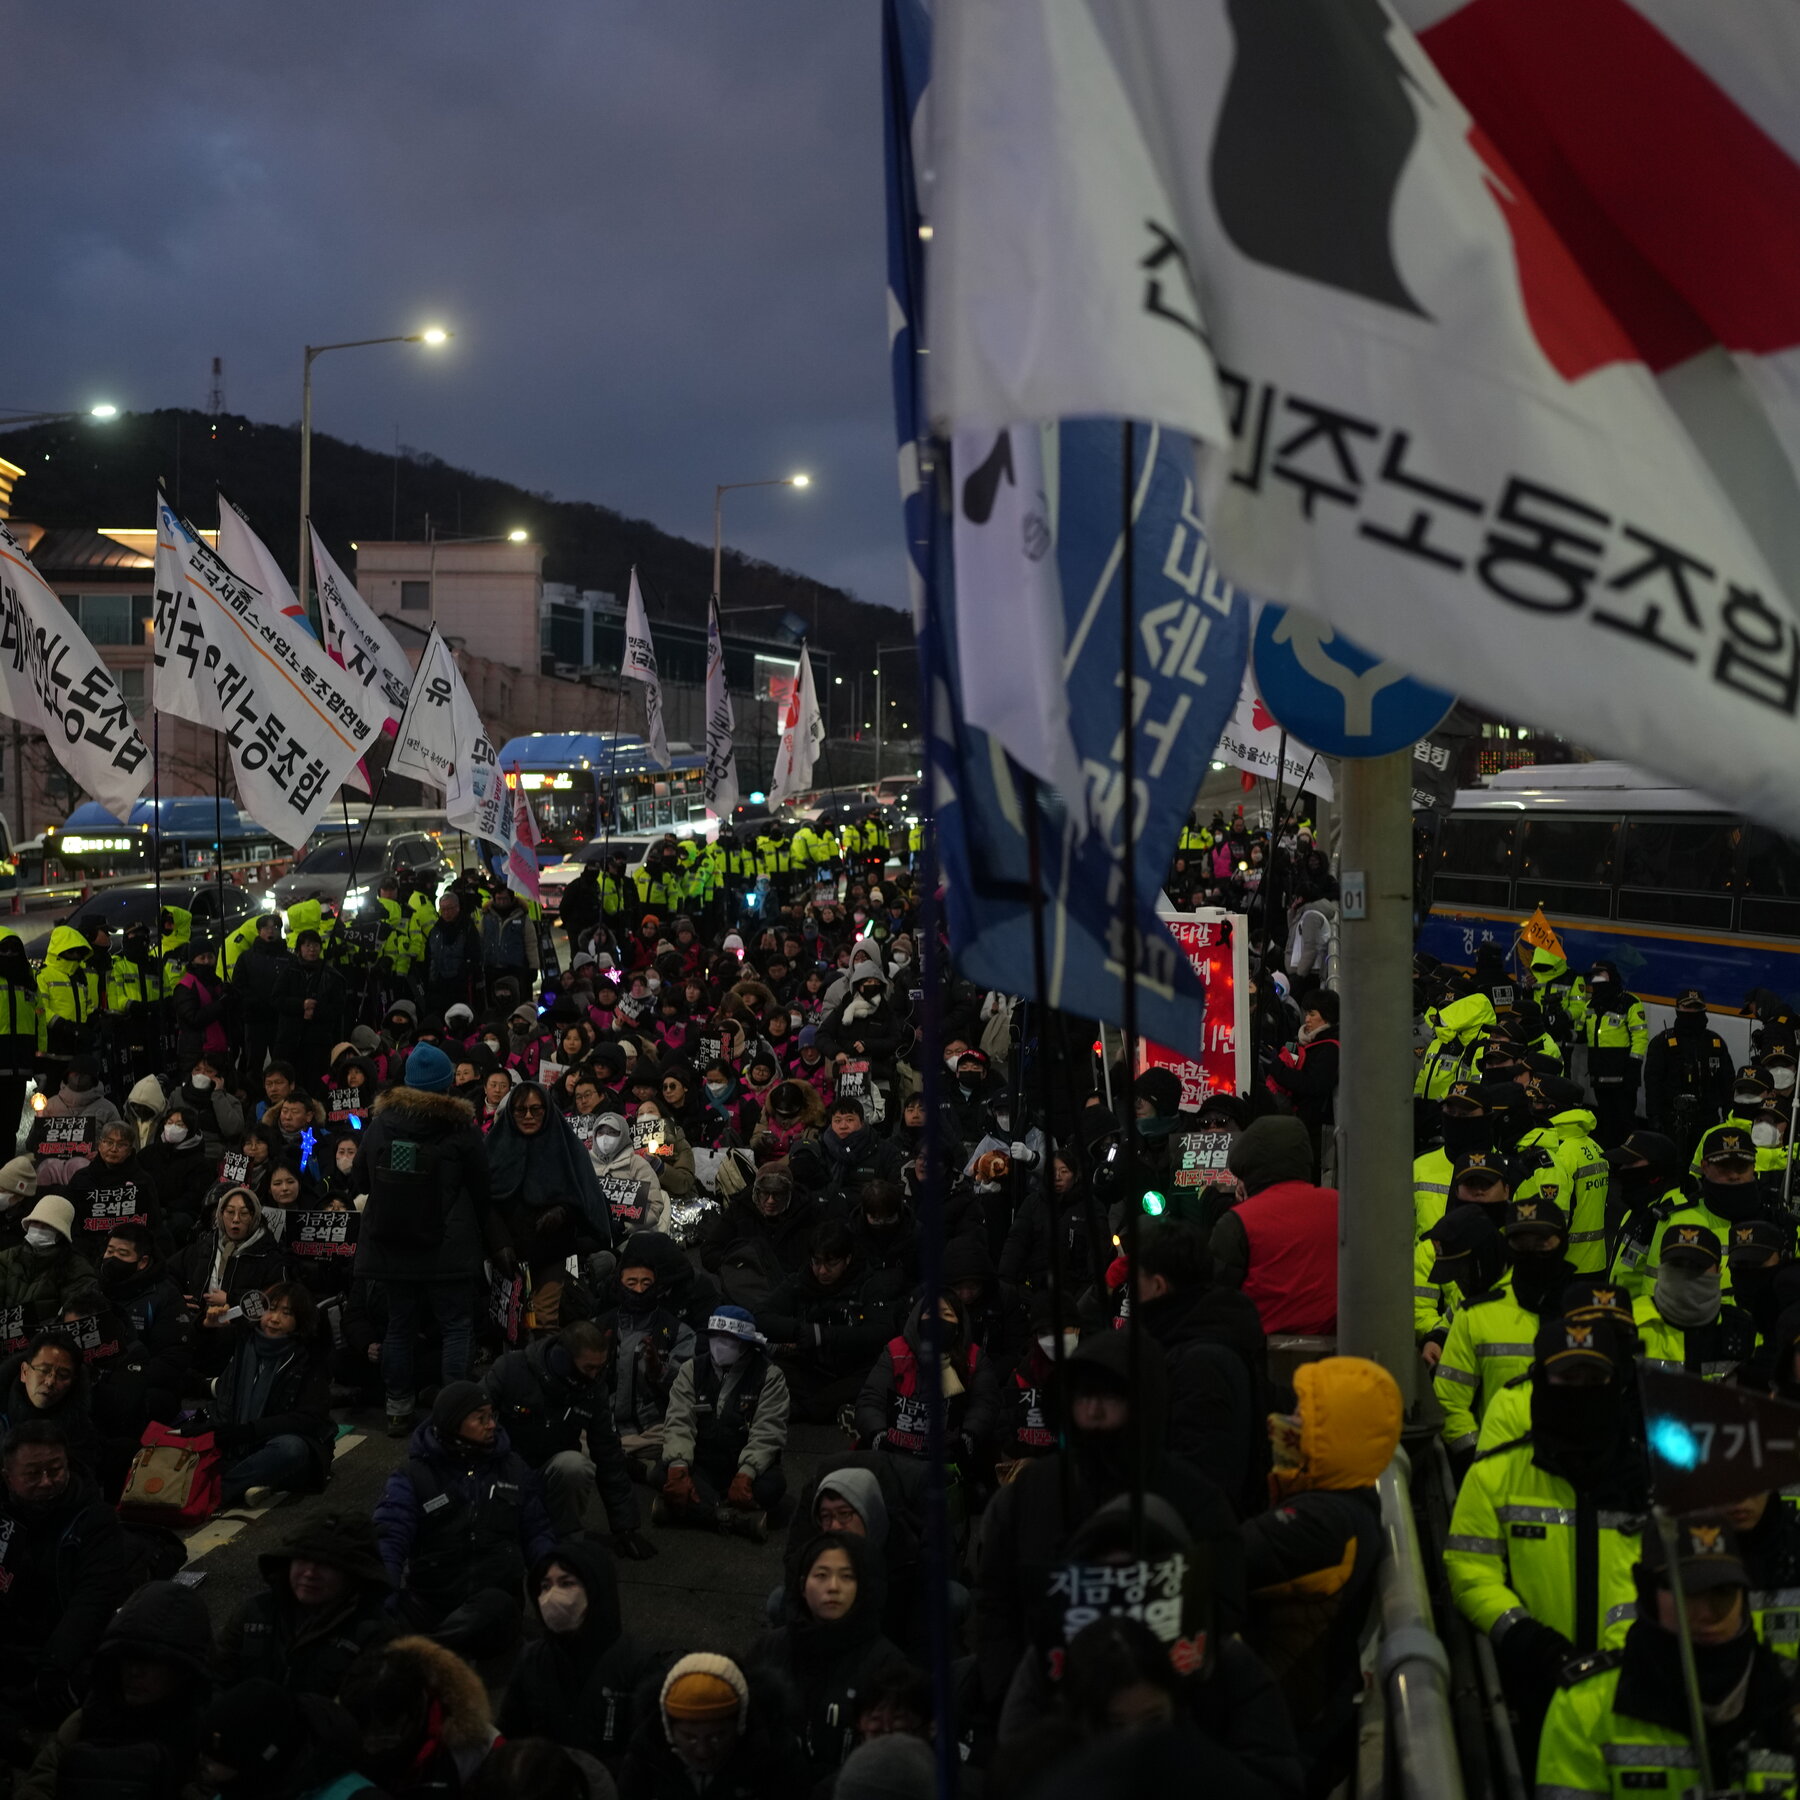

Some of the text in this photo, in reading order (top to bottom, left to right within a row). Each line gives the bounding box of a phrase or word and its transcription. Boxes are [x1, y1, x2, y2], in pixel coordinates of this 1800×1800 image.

[1345, 891, 1362, 909] 01
[43, 1117, 88, 1129] 지금당장
[629, 1119, 666, 1136] 지금당장
[46, 1128, 86, 1143] 윤석열
[1178, 1132, 1234, 1151] 지금당장
[1182, 1149, 1229, 1169] 윤석열
[599, 1178, 642, 1192] 지금당장
[86, 1185, 140, 1203] 지금당장
[91, 1200, 137, 1217] 윤석열
[296, 1212, 350, 1227] 지금당장
[300, 1226, 347, 1242] 윤석열
[1046, 1552, 1191, 1607] 지금당장
